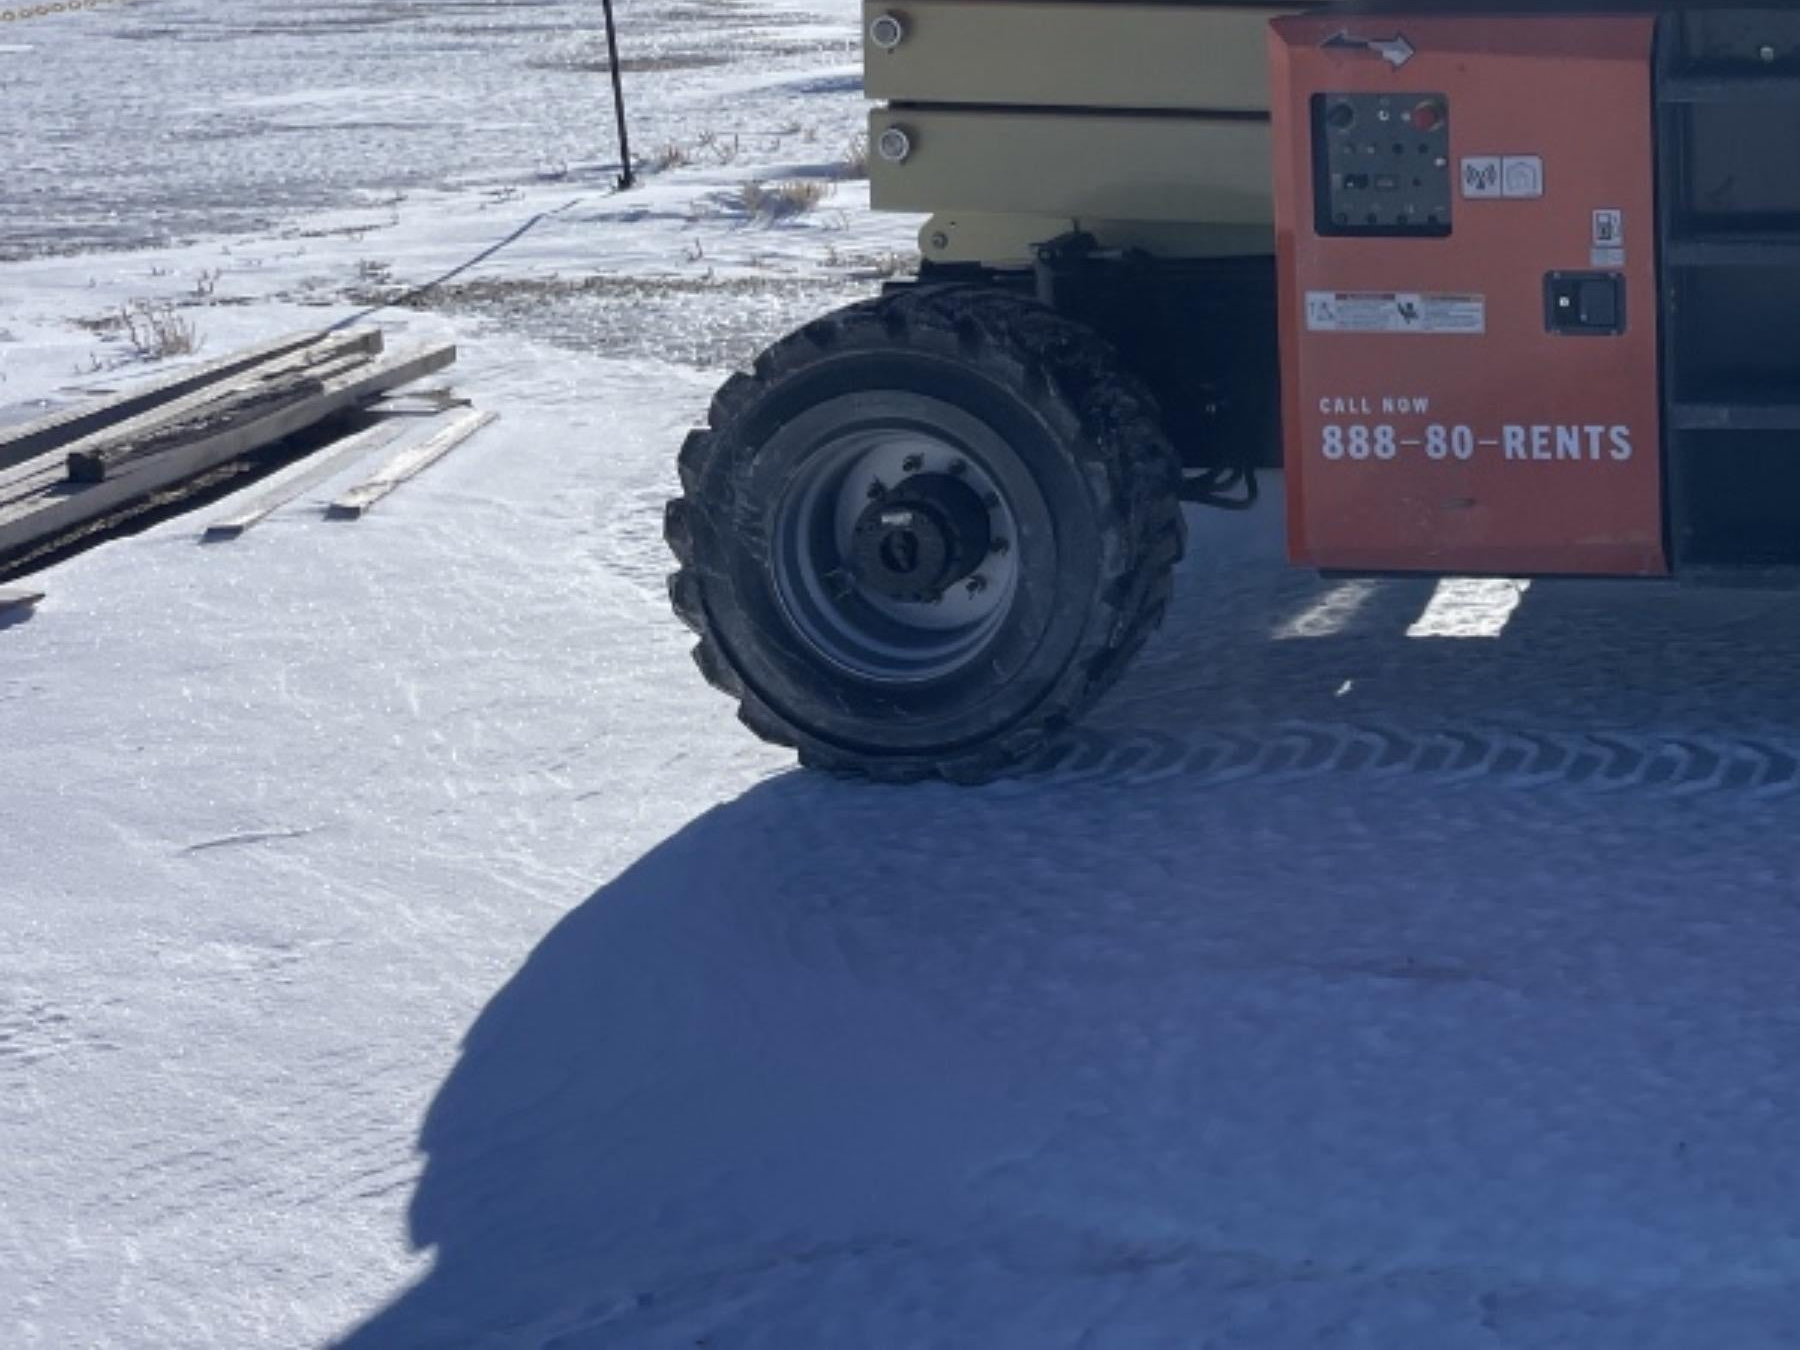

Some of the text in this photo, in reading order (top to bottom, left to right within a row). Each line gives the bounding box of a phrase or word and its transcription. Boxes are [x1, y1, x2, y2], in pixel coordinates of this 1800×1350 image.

[1319, 397, 1429, 414] CALL NOW
[1322, 424, 1632, 460] 888-80-RENTS
